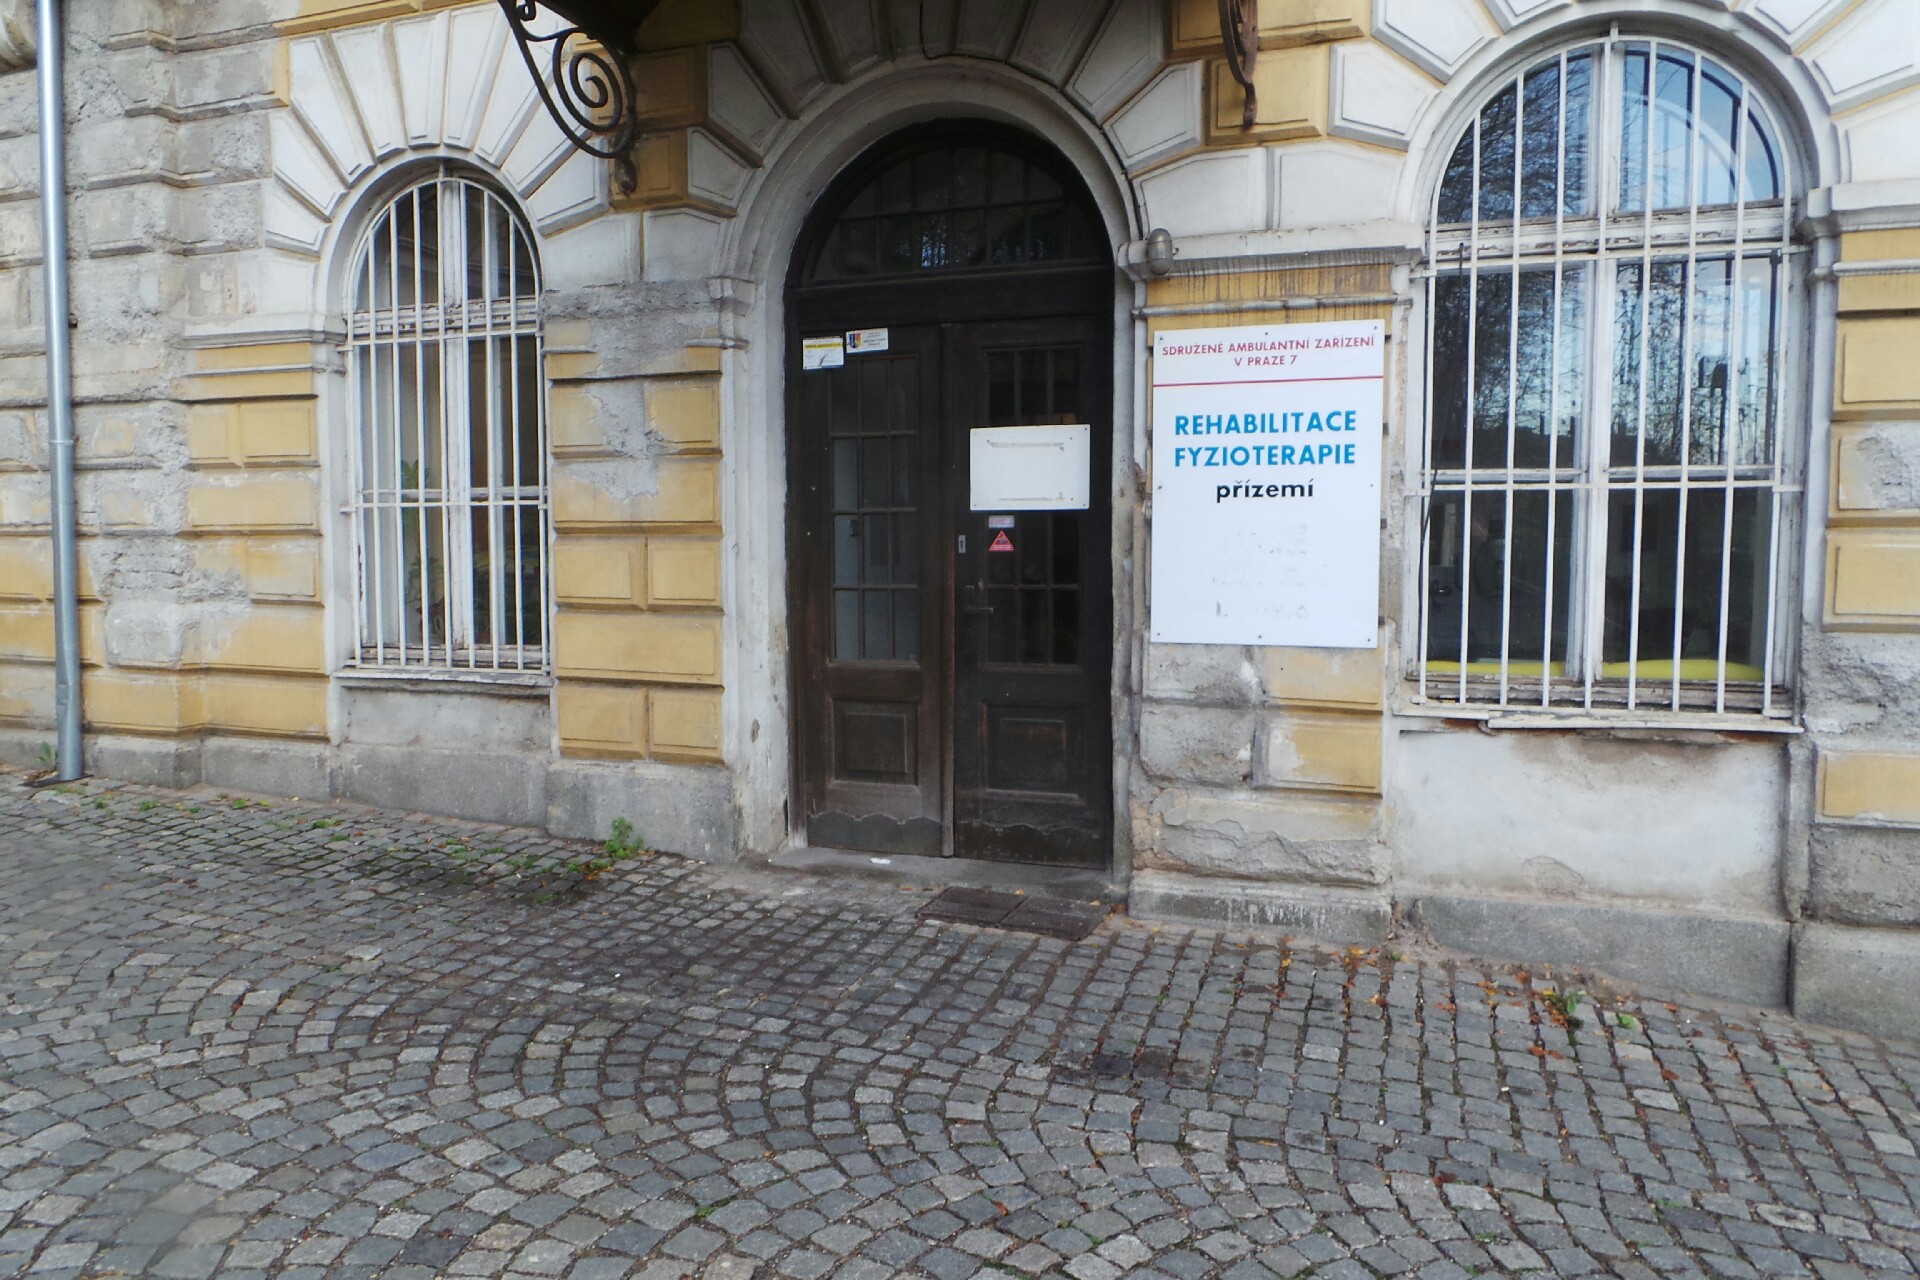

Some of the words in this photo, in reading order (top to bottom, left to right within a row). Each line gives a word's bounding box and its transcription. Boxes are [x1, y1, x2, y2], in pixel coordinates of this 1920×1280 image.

[1226, 336, 1310, 353] AMBULANTNÍ
[1234, 357, 1243, 367] V
[1247, 355, 1286, 367] PRAZE
[1290, 354, 1298, 365] 7
[1175, 410, 1357, 436] REHABILITACE
[1174, 443, 1356, 468] FYZIOTERAPIE
[1216, 478, 1314, 503] přízemí
